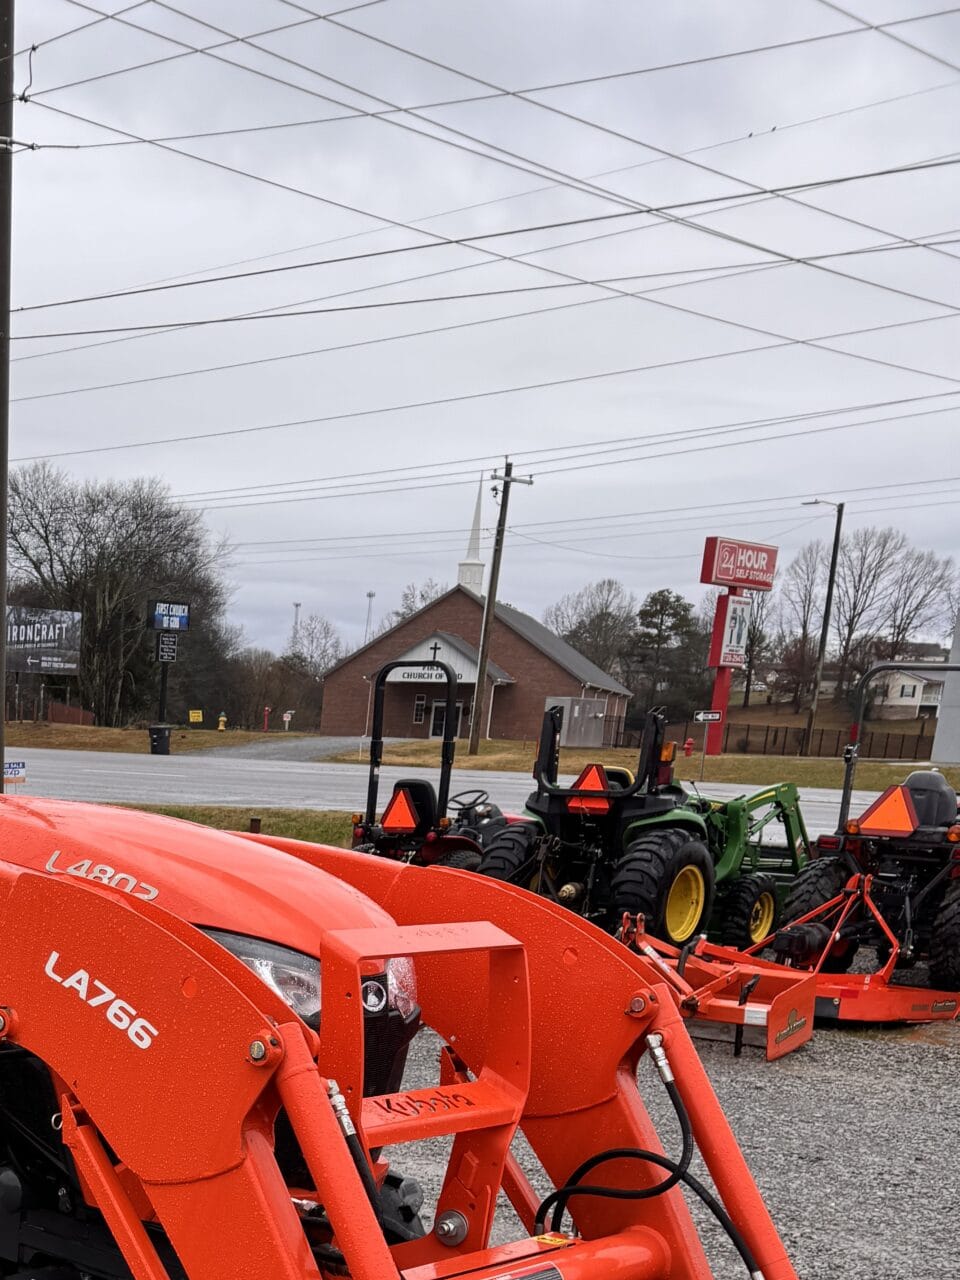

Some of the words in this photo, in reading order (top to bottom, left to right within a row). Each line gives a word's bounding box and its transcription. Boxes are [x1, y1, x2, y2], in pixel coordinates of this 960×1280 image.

[721, 550, 736, 576] 24
[737, 547, 768, 571] HOUR
[735, 568, 749, 580] SELF
[749, 570, 774, 584] STORAGE
[155, 602, 169, 615] FIRST
[170, 604, 189, 617] CHURCH
[402, 671, 433, 680] CHURCH
[43, 950, 160, 1051] LA766
[373, 1090, 476, 1117] Kubota
